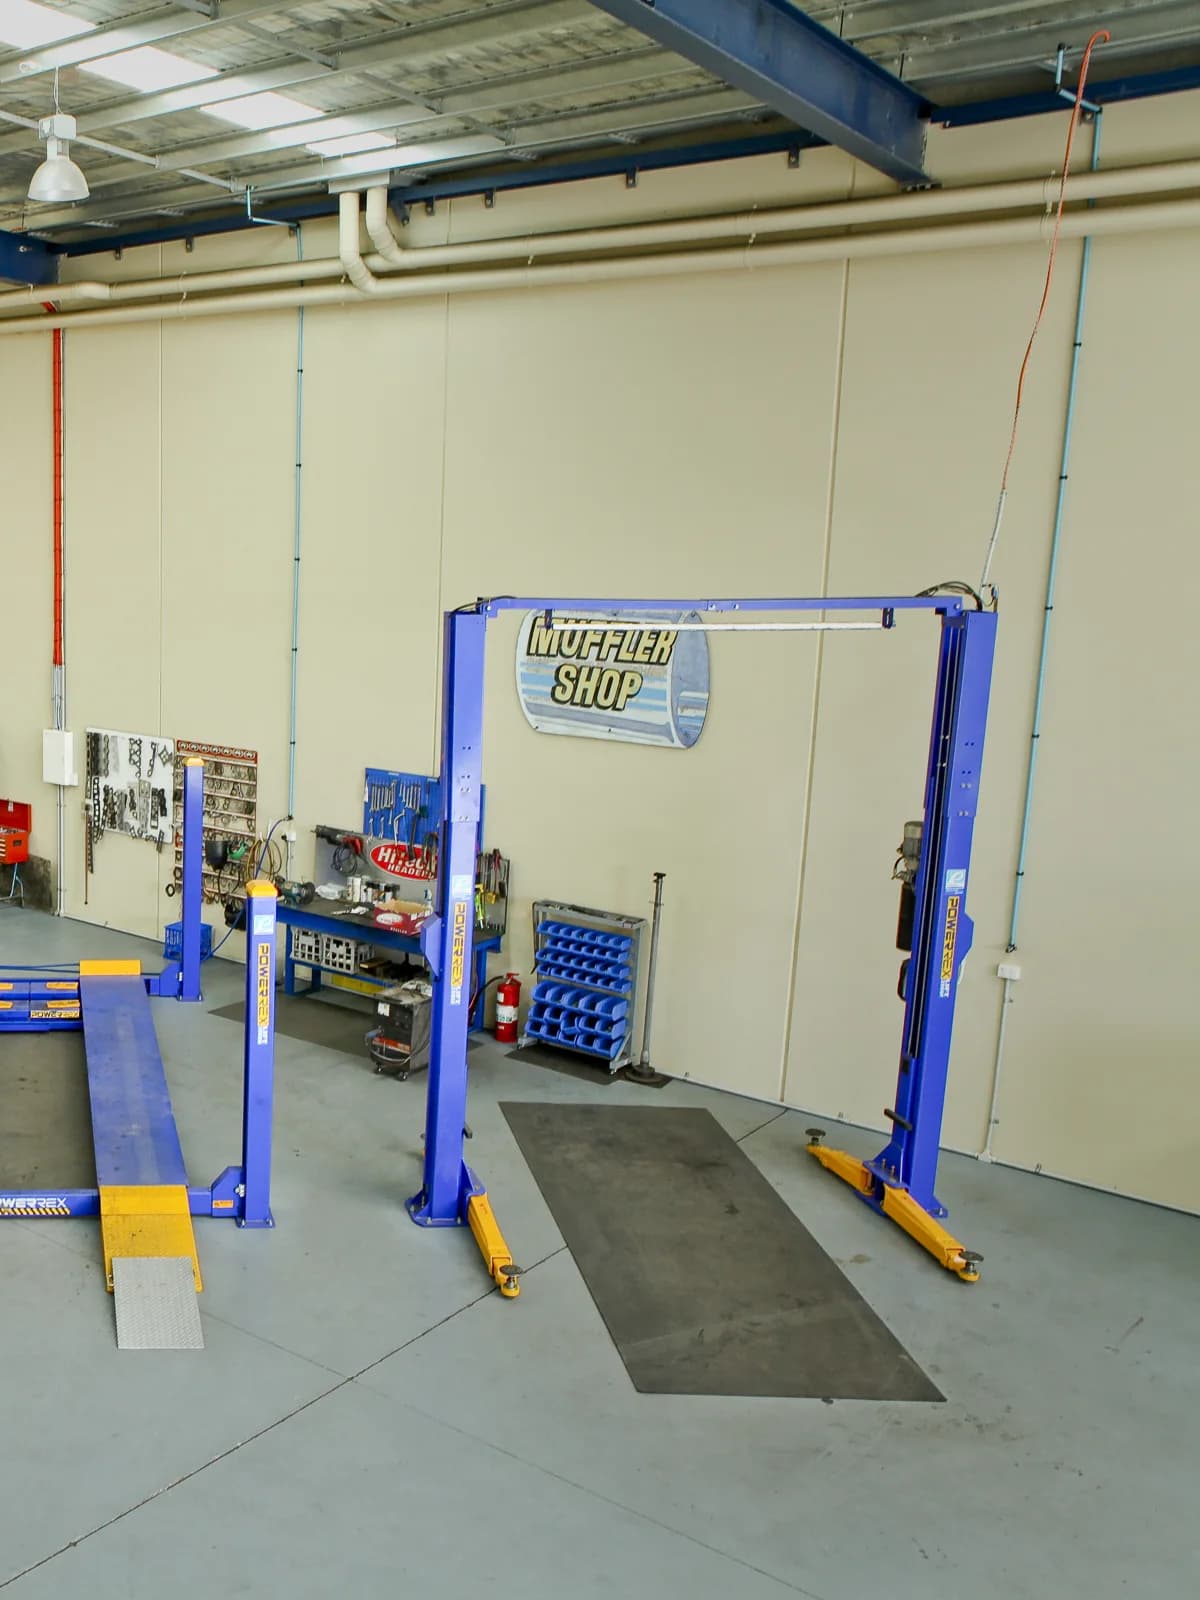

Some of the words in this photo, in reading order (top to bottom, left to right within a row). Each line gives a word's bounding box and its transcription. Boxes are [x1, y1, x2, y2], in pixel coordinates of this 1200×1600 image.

[527, 617, 678, 665] MUFFLER
[552, 664, 643, 711] SHOP
[452, 902, 466, 985] POWERREX
[942, 897, 959, 979] POWERREX
[258, 944, 269, 1026] POWERREX
